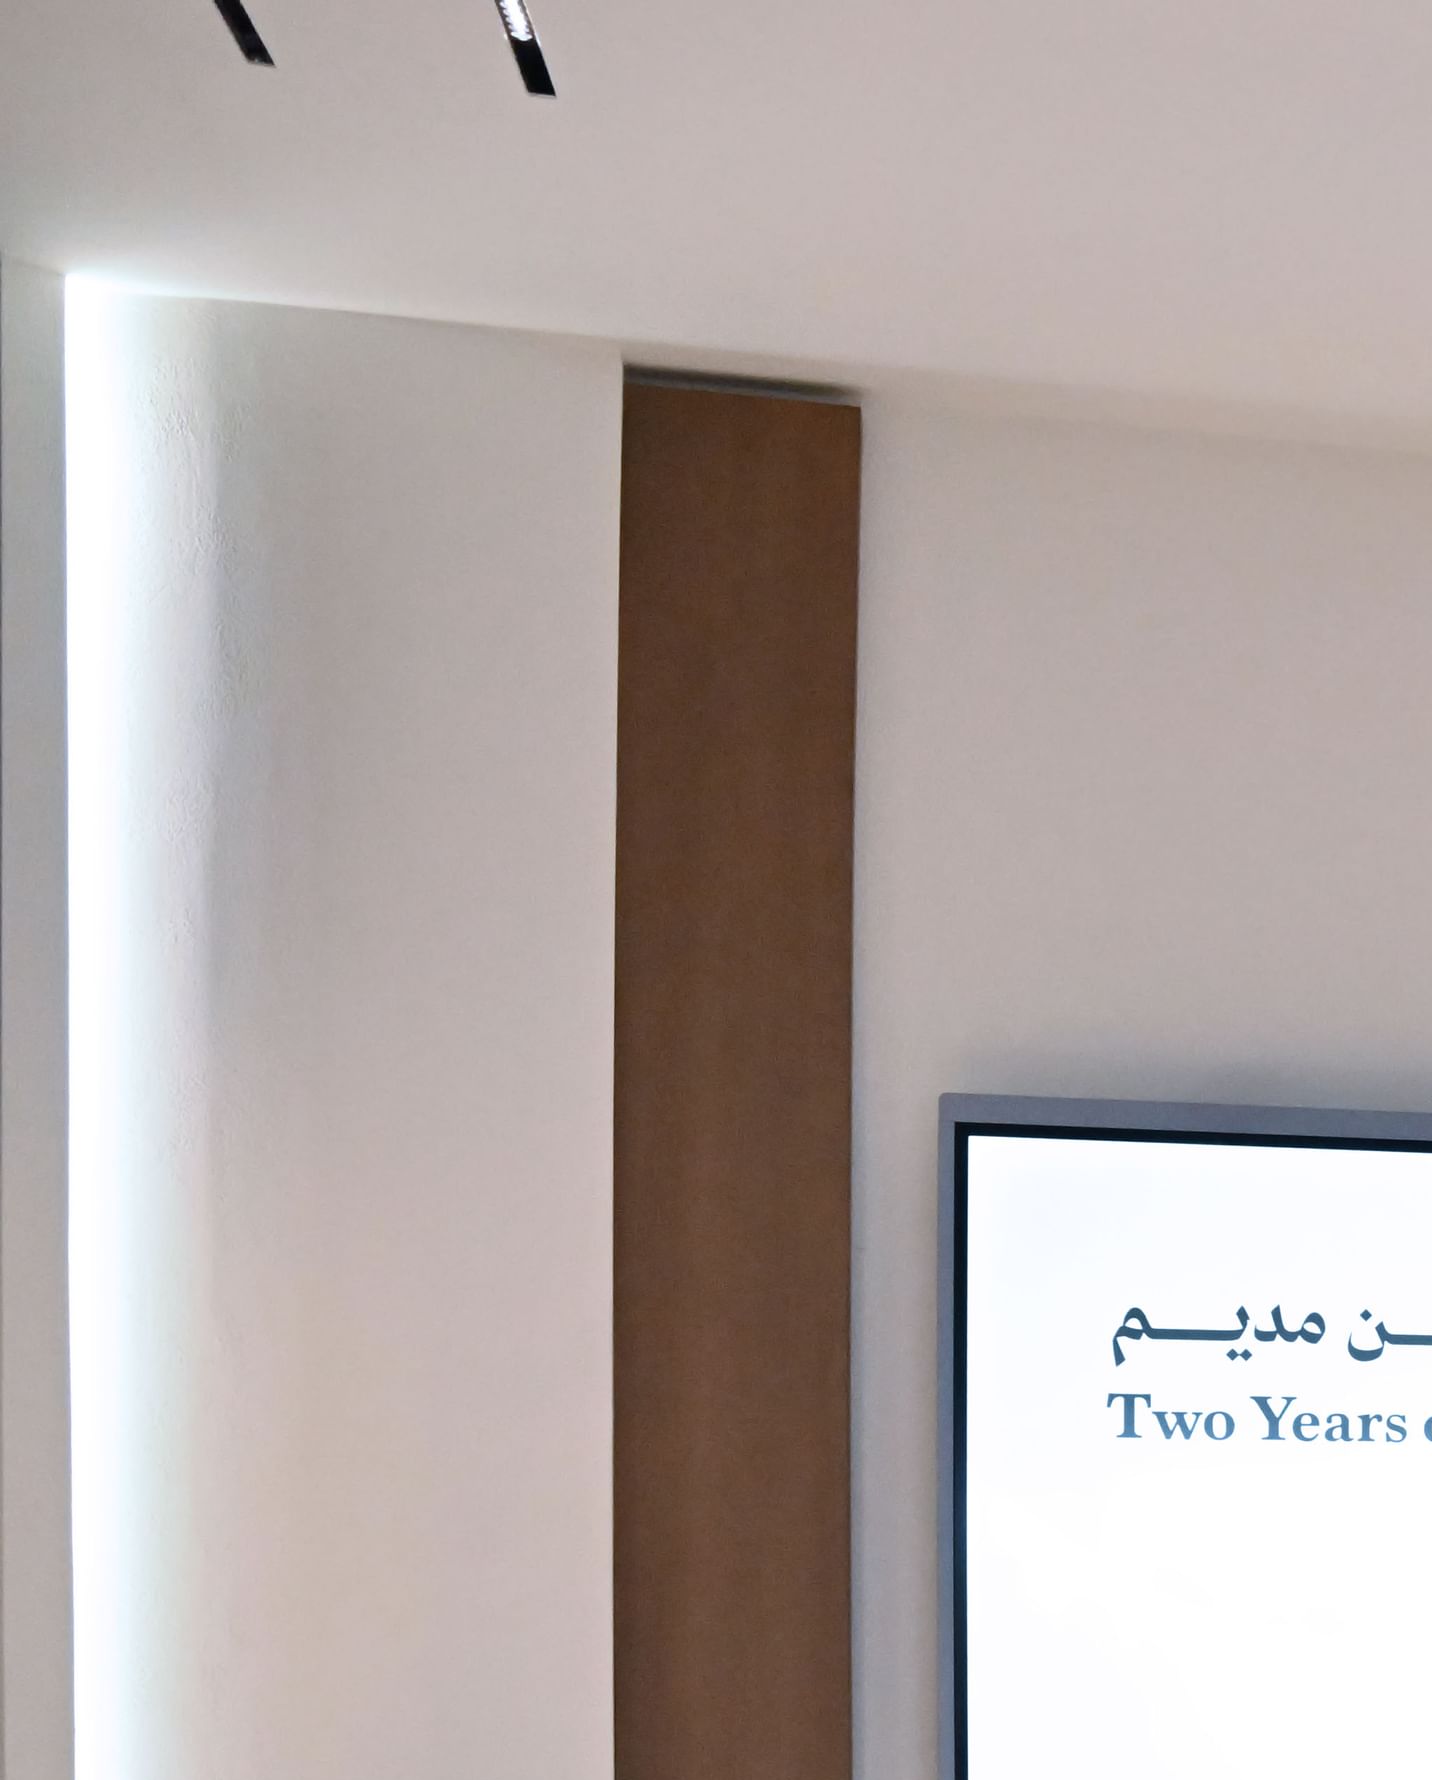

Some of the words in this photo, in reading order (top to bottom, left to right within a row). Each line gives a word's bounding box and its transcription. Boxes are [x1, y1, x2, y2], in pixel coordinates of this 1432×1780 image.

[1112, 1304, 1326, 1367] مديم
[1107, 1392, 1236, 1440] Two
[1250, 1395, 1408, 1443] Years
